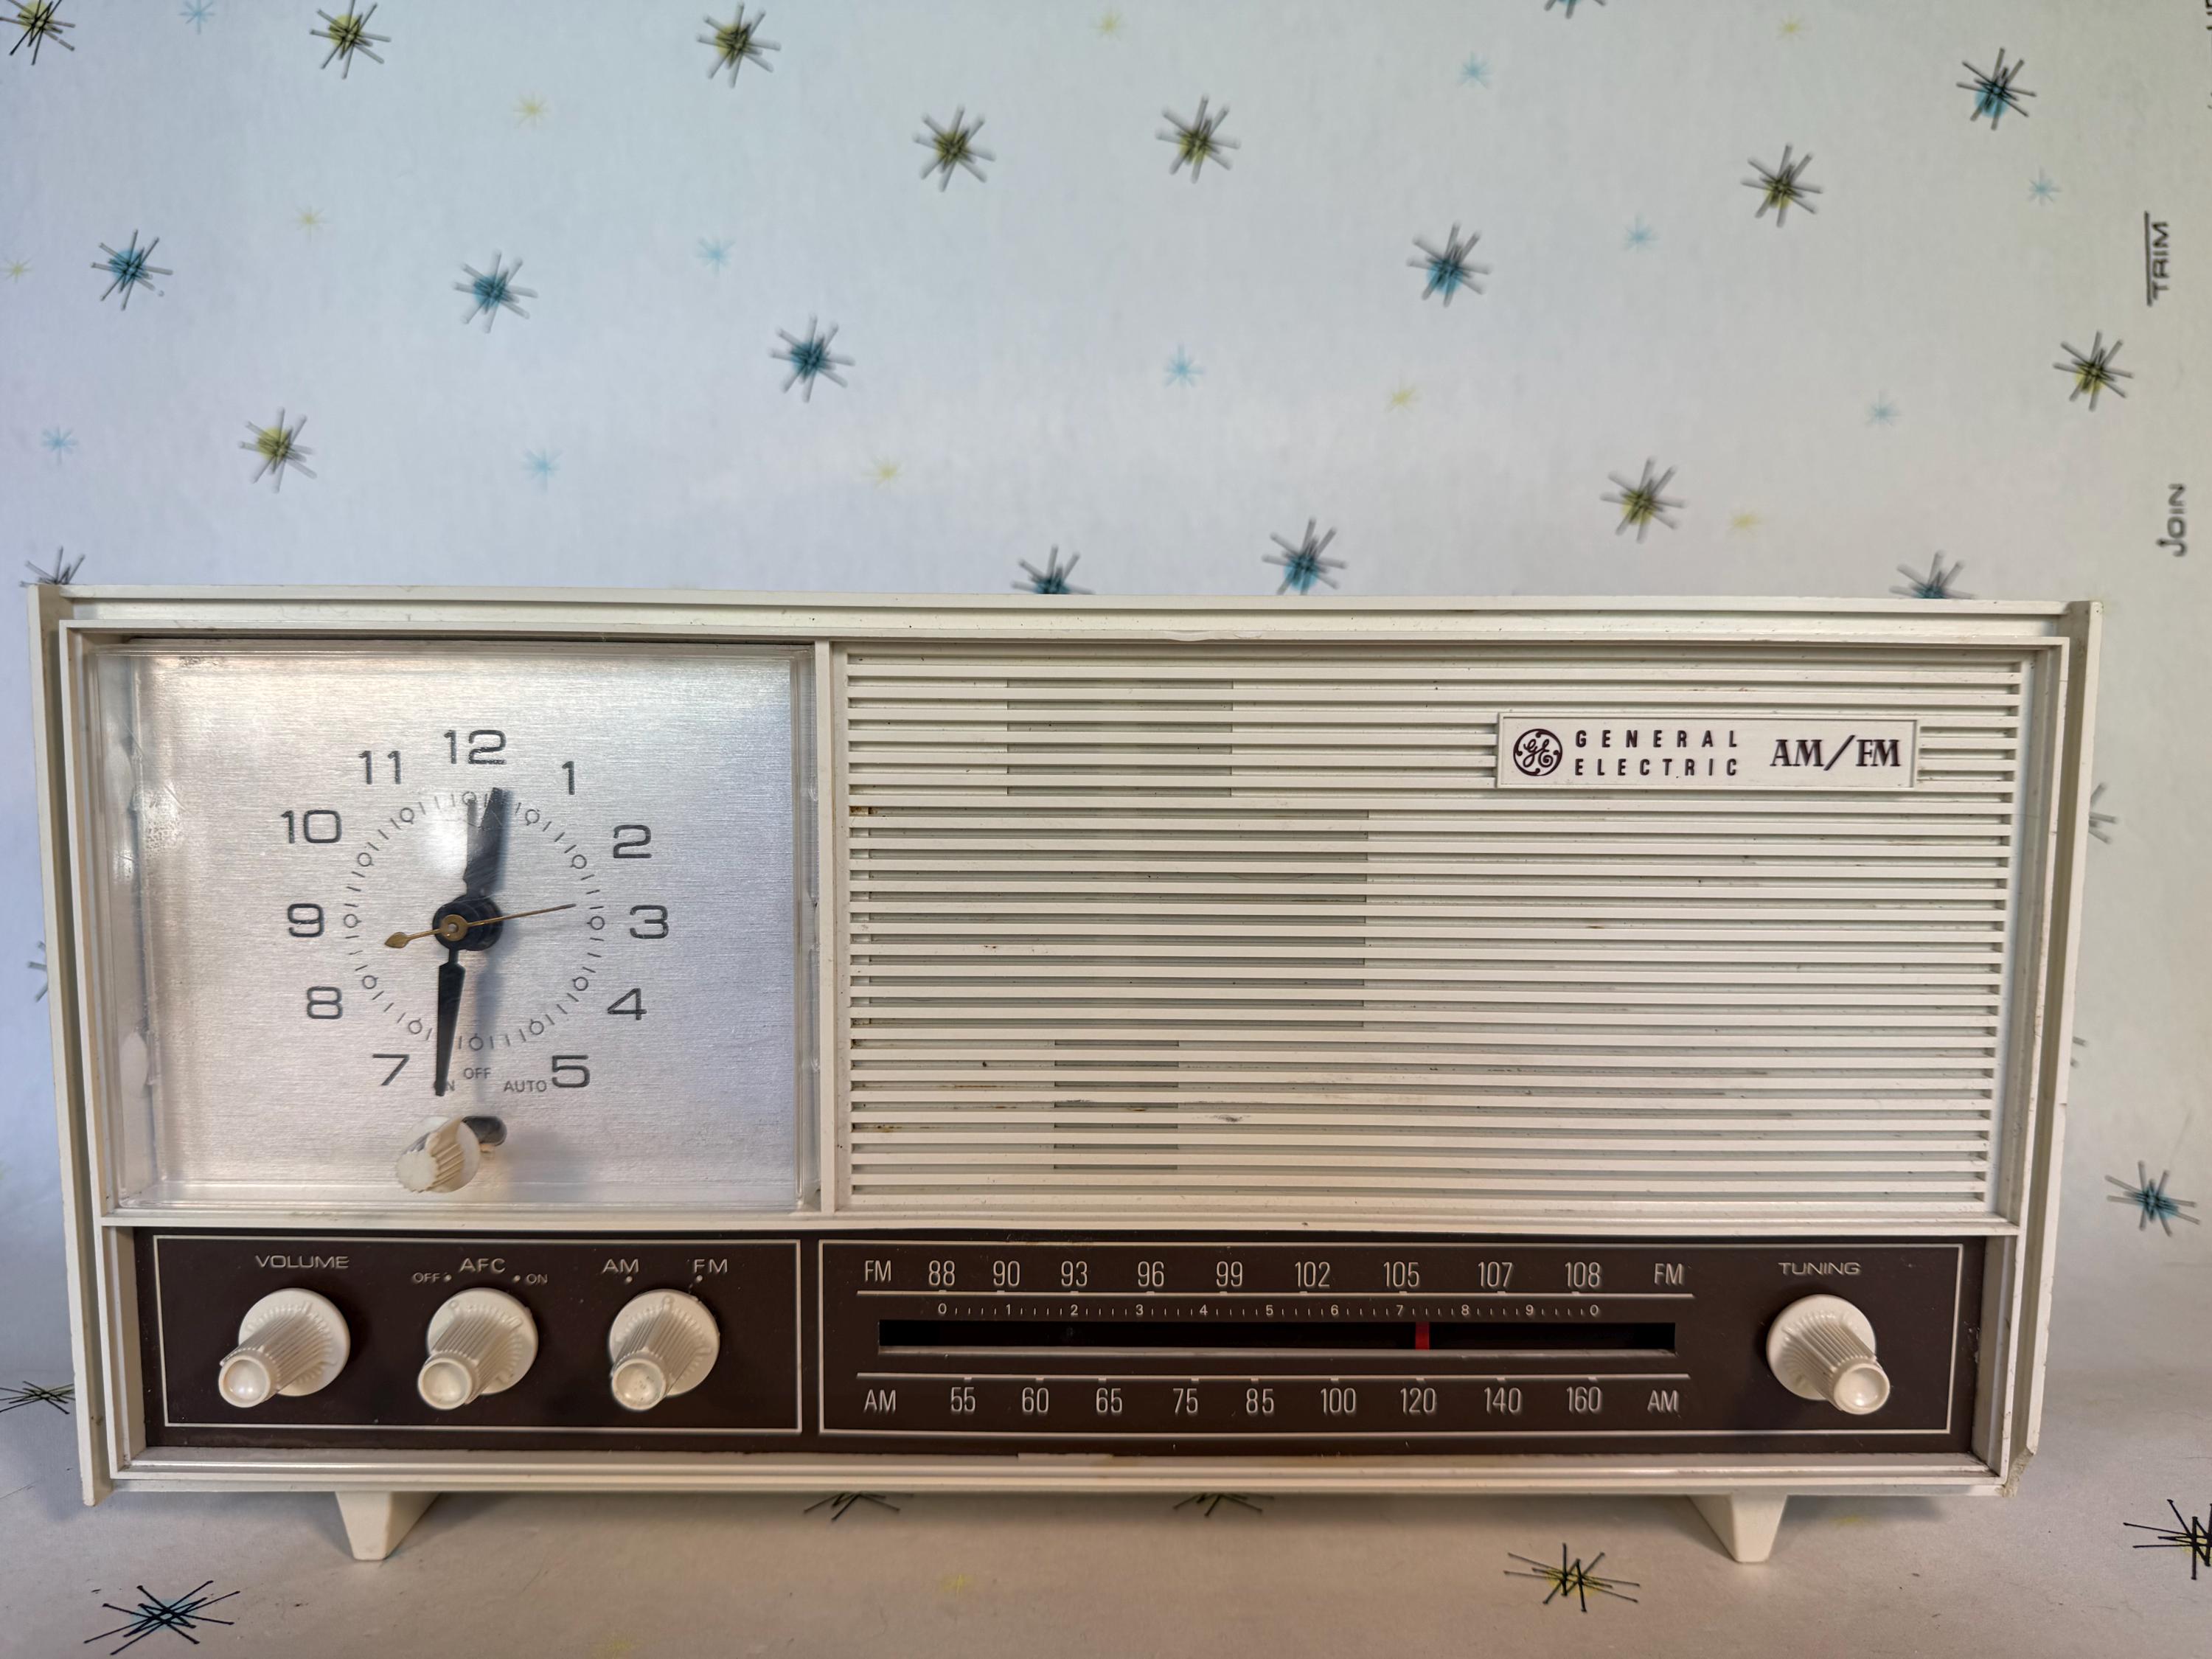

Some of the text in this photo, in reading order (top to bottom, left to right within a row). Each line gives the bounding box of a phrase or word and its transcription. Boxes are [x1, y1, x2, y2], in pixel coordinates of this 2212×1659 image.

[2151, 223, 2169, 298] TRIM
[2156, 482, 2187, 557] JOIN
[444, 729, 507, 765] 12
[1575, 729, 1737, 748] GENERAL
[1770, 735, 1901, 771] AM/FM
[359, 751, 402, 785] 11
[562, 761, 575, 795] 1
[1575, 758, 1738, 776] ELECTRIC
[281, 810, 342, 844] 10
[613, 824, 652, 859] 2
[287, 903, 324, 938] 9
[630, 905, 669, 939] 3
[306, 986, 343, 1020] 8
[608, 988, 647, 1020] 4
[372, 1054, 409, 1086] 7
[463, 1068, 491, 1079] OFF
[552, 1054, 591, 1088] 5
[504, 1080, 547, 1093] AUTO
[255, 1255, 349, 1270] VOLUME
[459, 1258, 506, 1274] AFC
[602, 1258, 639, 1274] AM
[694, 1258, 728, 1274] FM
[864, 1260, 1684, 1288] FM 88 90 93 96 99 102 105 107 108 FM
[1778, 1262, 1862, 1276] TUNING
[412, 1272, 440, 1284] OFF
[526, 1272, 548, 1285] ON
[938, 1303, 1599, 1317] 0 1 2 3 4 5 6 7 8 9 0
[863, 1387, 1680, 1415] AM 55 60 65 75 85 100 120 140 160 AM
